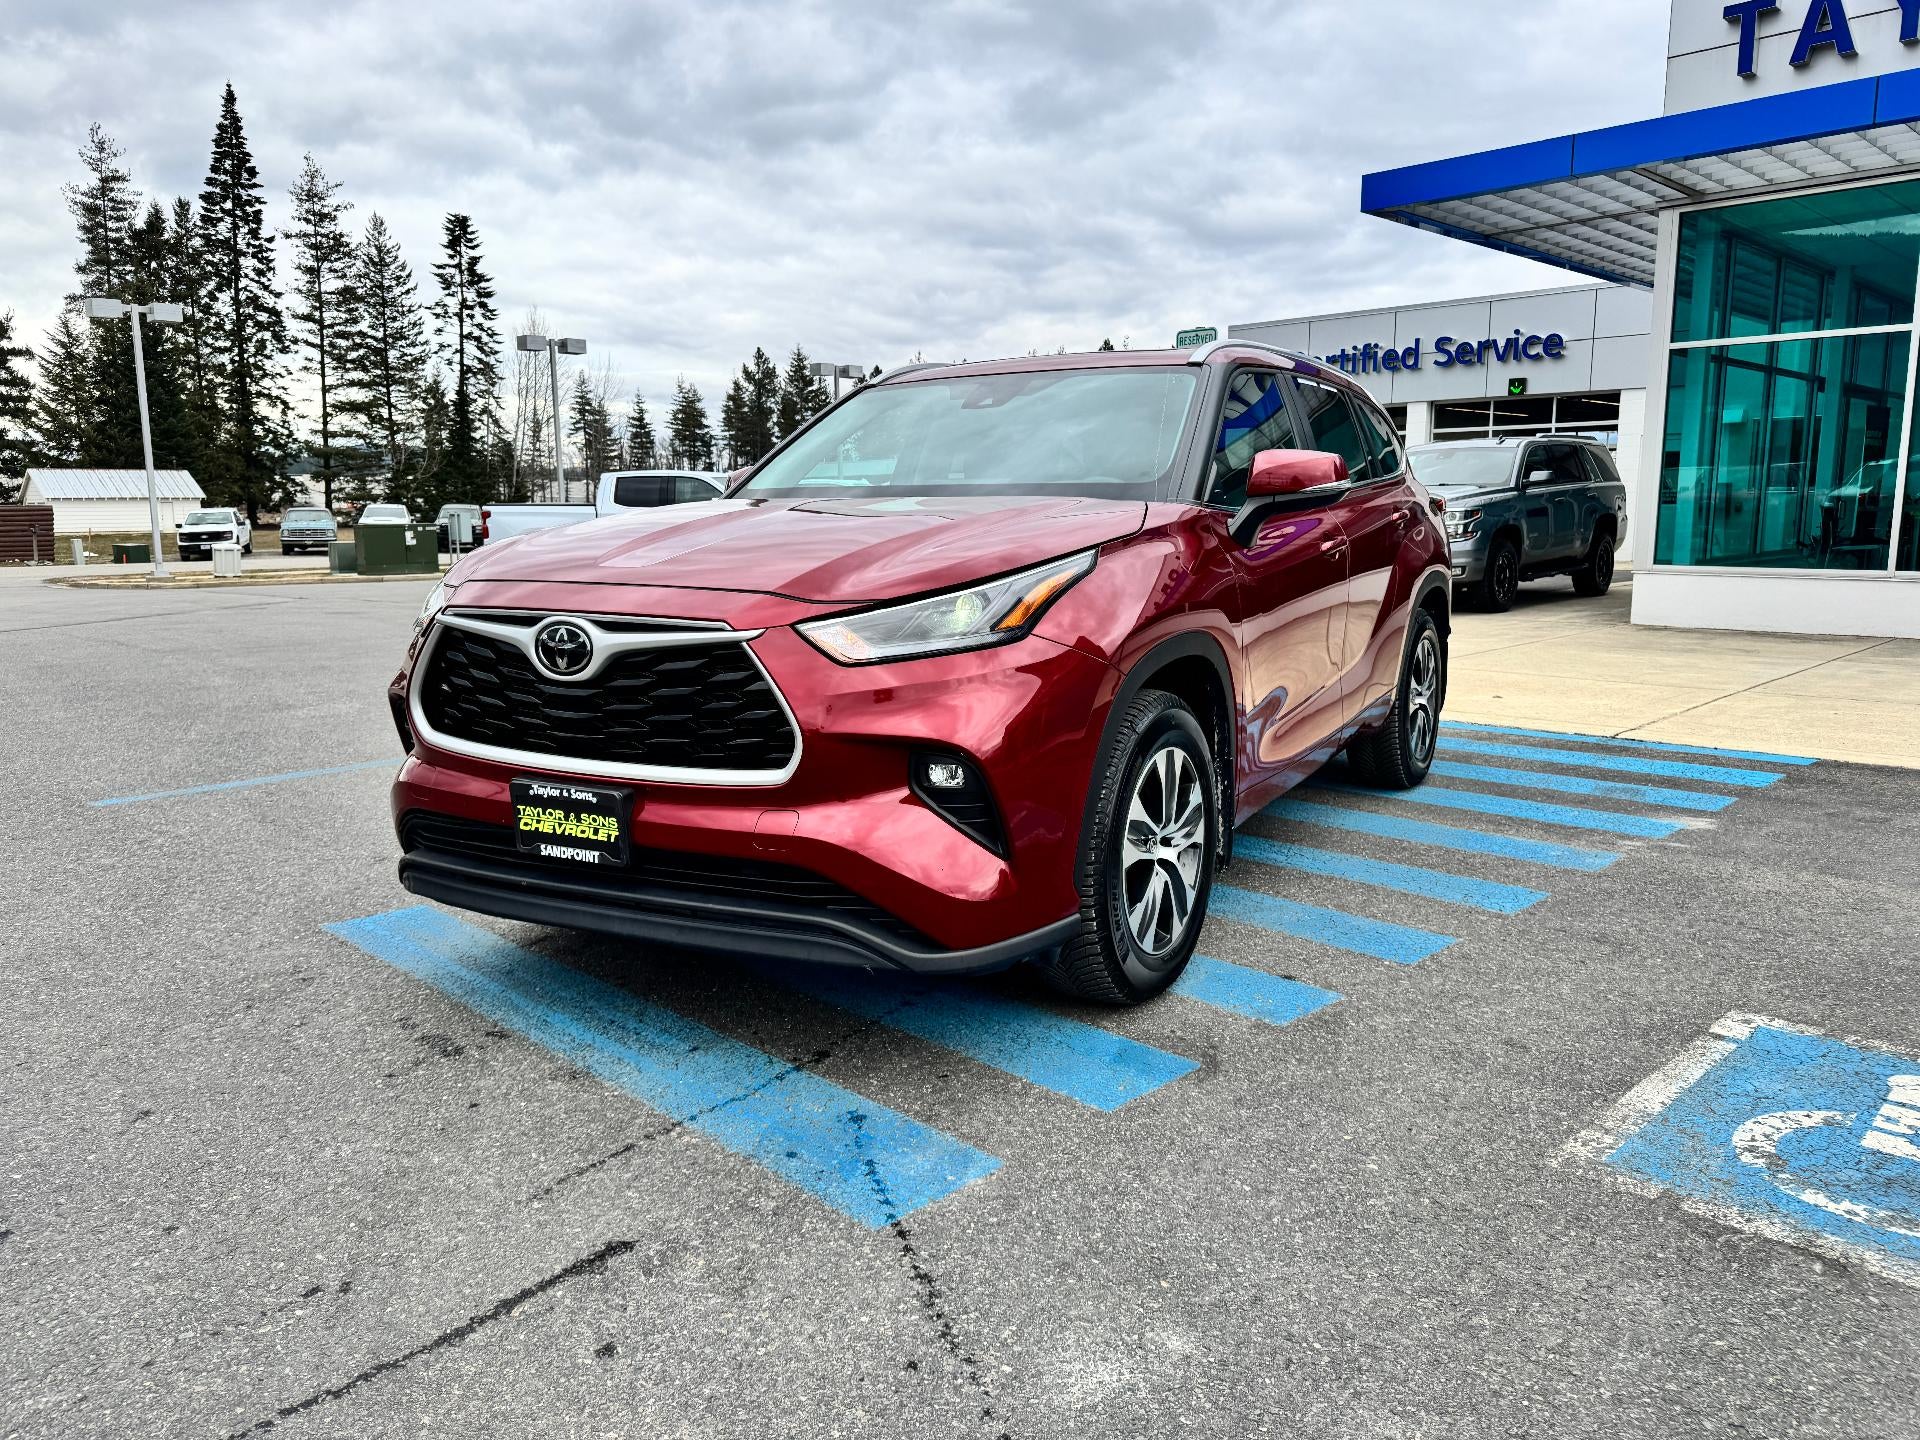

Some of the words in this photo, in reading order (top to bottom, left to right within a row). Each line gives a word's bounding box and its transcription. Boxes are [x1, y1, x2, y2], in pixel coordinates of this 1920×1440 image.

[1179, 333, 1214, 347] RESERVED
[1312, 338, 1421, 373] rtified
[1432, 329, 1565, 368] Service
[531, 784, 561, 798] Taylor
[563, 790, 569, 798] &
[570, 788, 593, 801] Sons
[516, 805, 565, 821] TAYLOR
[568, 812, 577, 825] &
[580, 813, 619, 829] SONS
[519, 818, 620, 843] CHEVROLET
[540, 844, 600, 864] SANDPOINT
